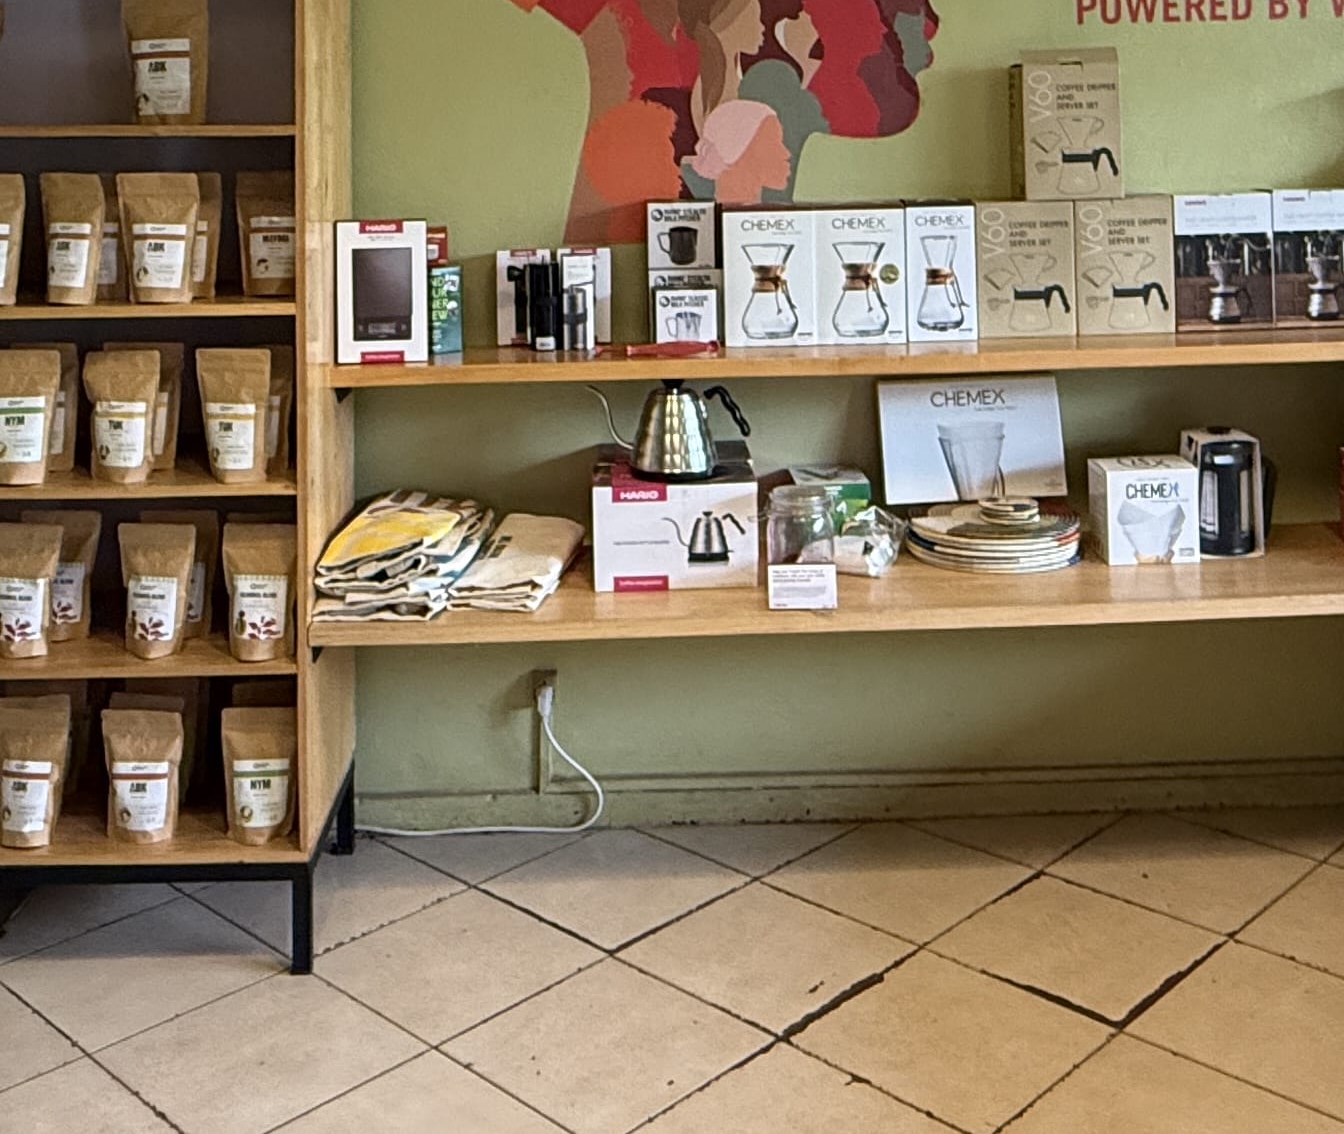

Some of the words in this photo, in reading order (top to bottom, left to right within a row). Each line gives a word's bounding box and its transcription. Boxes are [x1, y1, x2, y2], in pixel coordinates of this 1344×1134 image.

[1027, 70, 1052, 123] V60
[741, 217, 795, 232] CHEMEX
[831, 216, 886, 230] CHEMEX
[914, 214, 964, 227] CHEMEX
[1009, 221, 1036, 229] COFFEE
[1107, 219, 1136, 227] COFFEE
[981, 207, 1005, 259] V60
[1079, 206, 1104, 256] V60
[1108, 228, 1126, 236] AND
[1009, 239, 1035, 247] SERVER
[1108, 236, 1134, 245] SERVER
[930, 389, 1005, 408] CHEMEX
[620, 491, 659, 500] HARIO
[1125, 481, 1180, 500] CHEMEX
